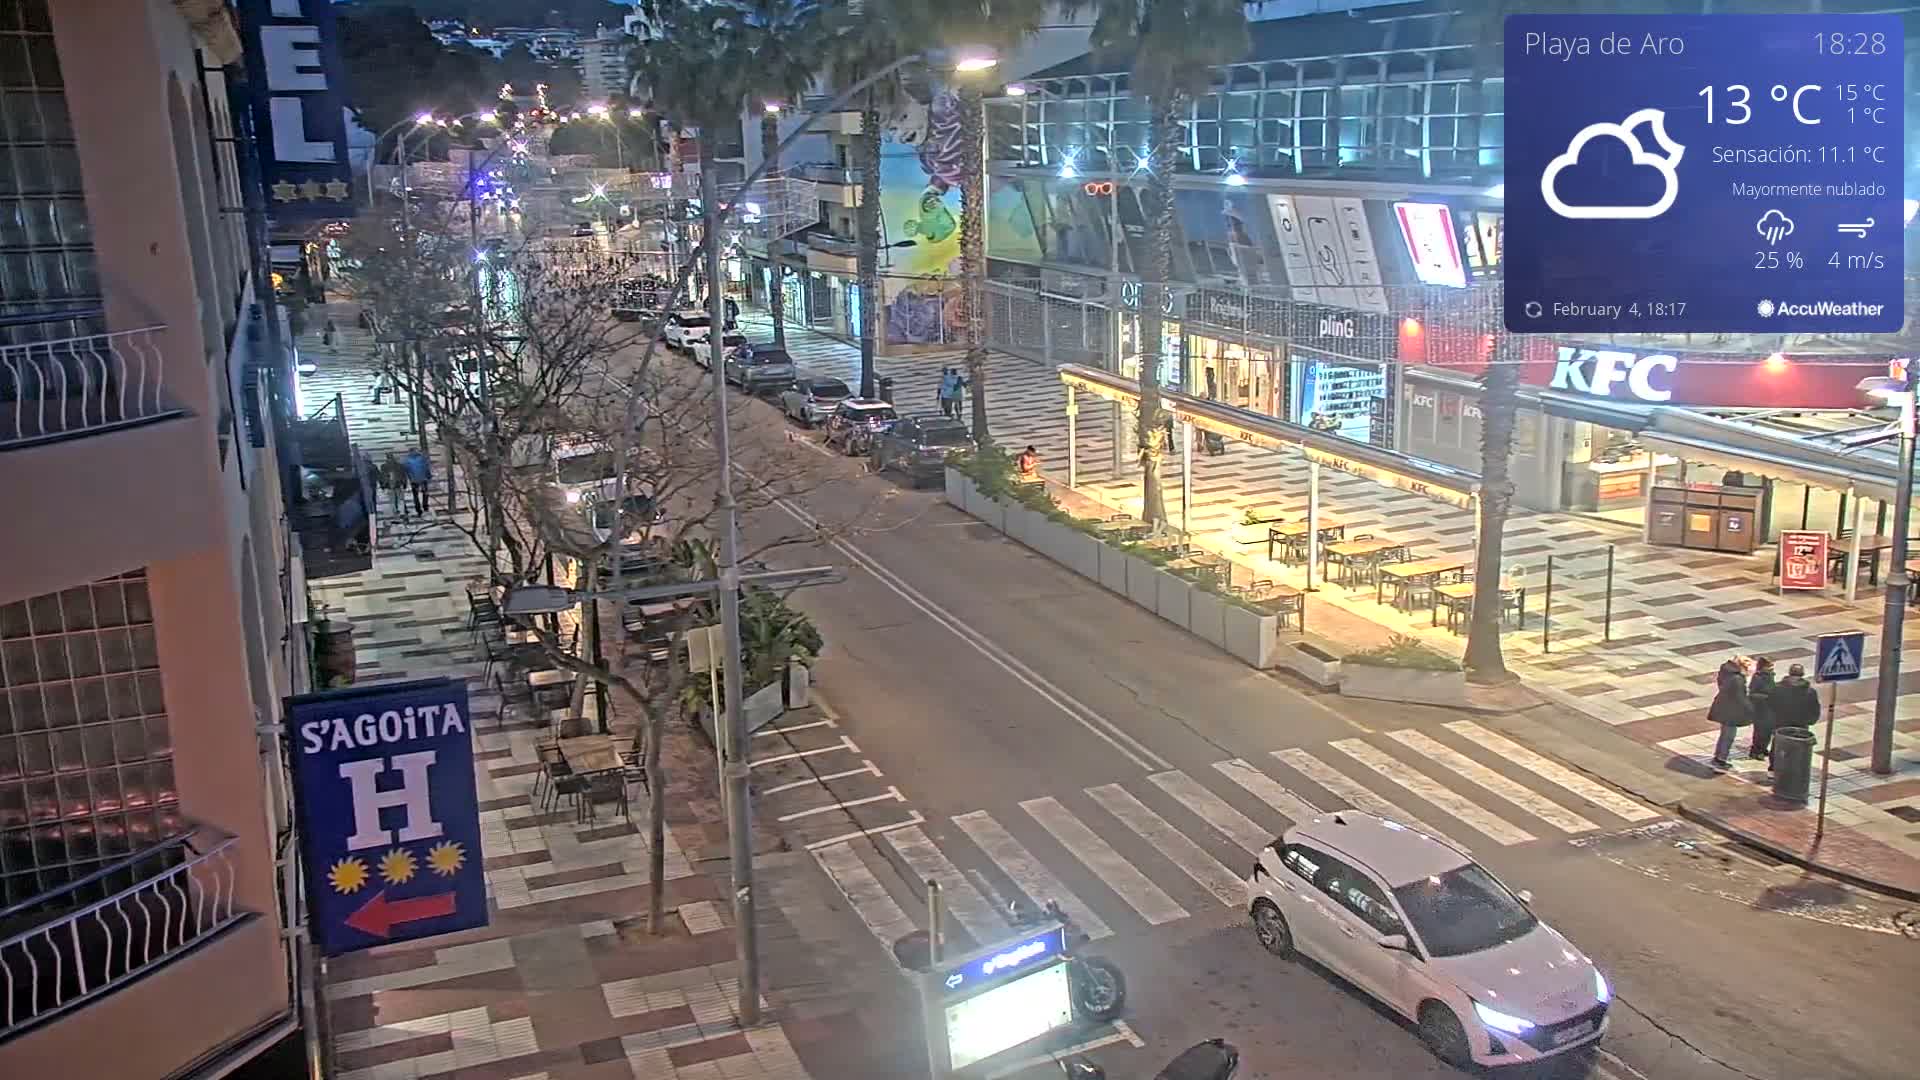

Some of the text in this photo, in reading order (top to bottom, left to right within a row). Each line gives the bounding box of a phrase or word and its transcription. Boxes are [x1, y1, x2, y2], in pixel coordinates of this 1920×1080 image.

[260, 0, 338, 163] EL
[1550, 347, 1678, 401] KFC
[339, 750, 444, 851] H
